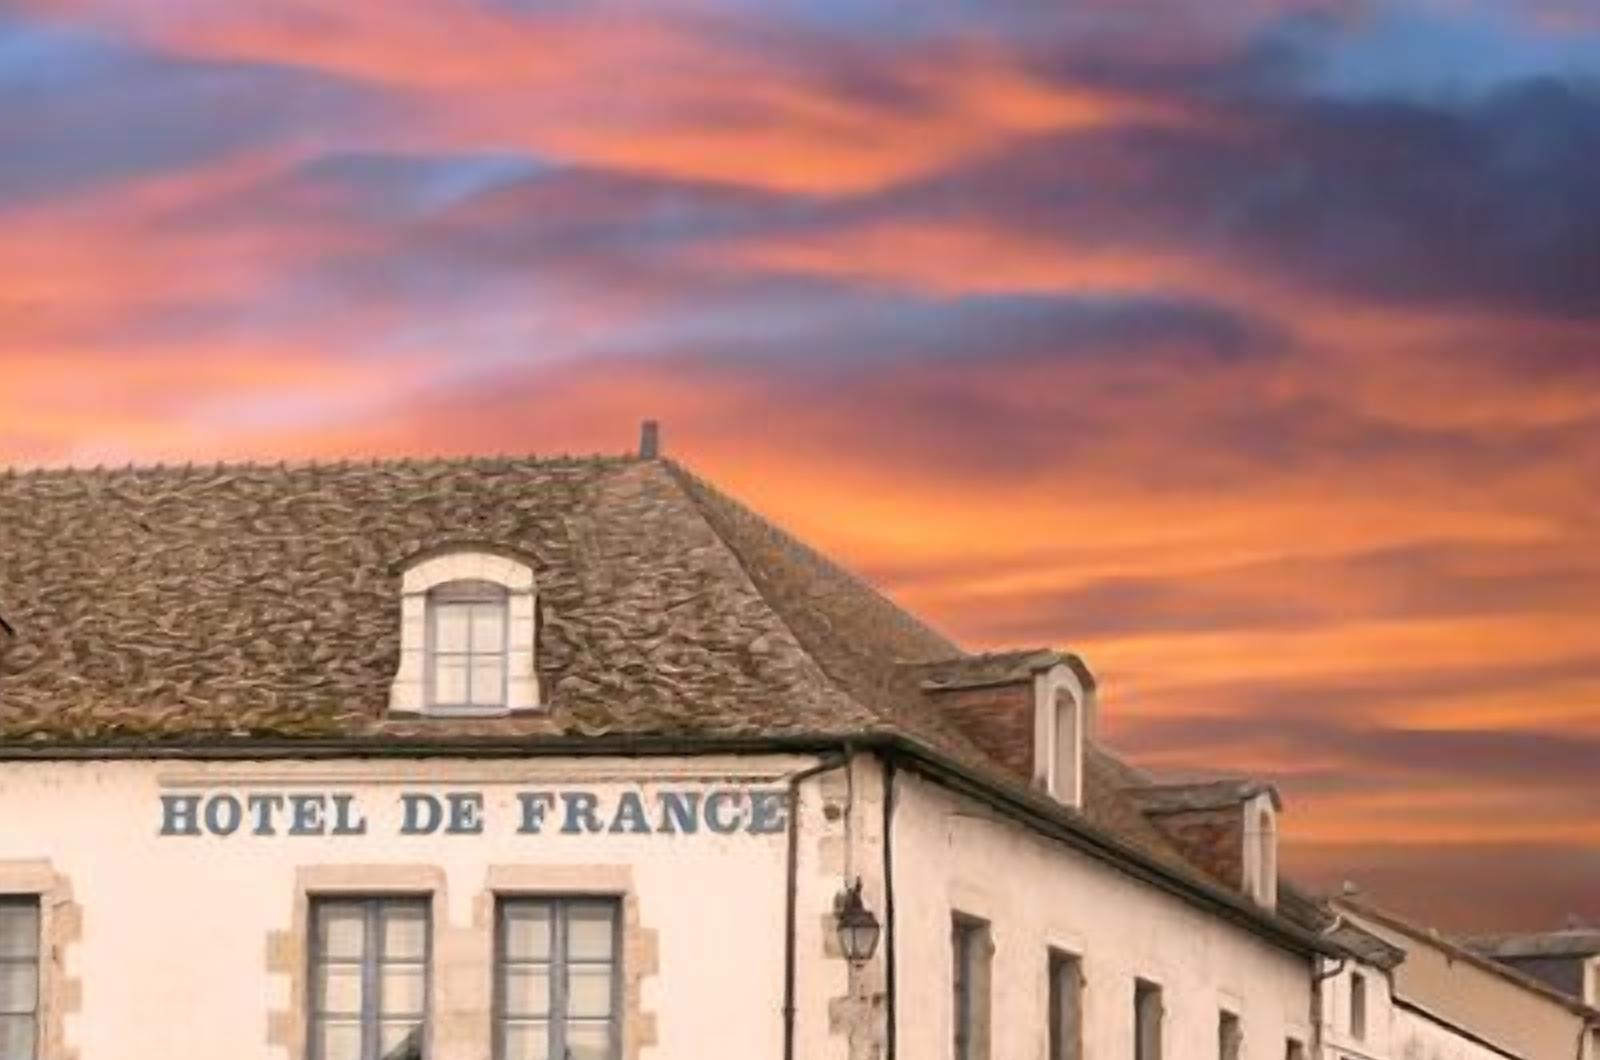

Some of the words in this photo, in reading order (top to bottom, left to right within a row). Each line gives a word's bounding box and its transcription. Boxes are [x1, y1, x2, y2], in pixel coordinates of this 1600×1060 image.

[158, 791, 367, 836] HOTEL
[400, 791, 485, 836] DE
[515, 791, 789, 836] FRANCE
